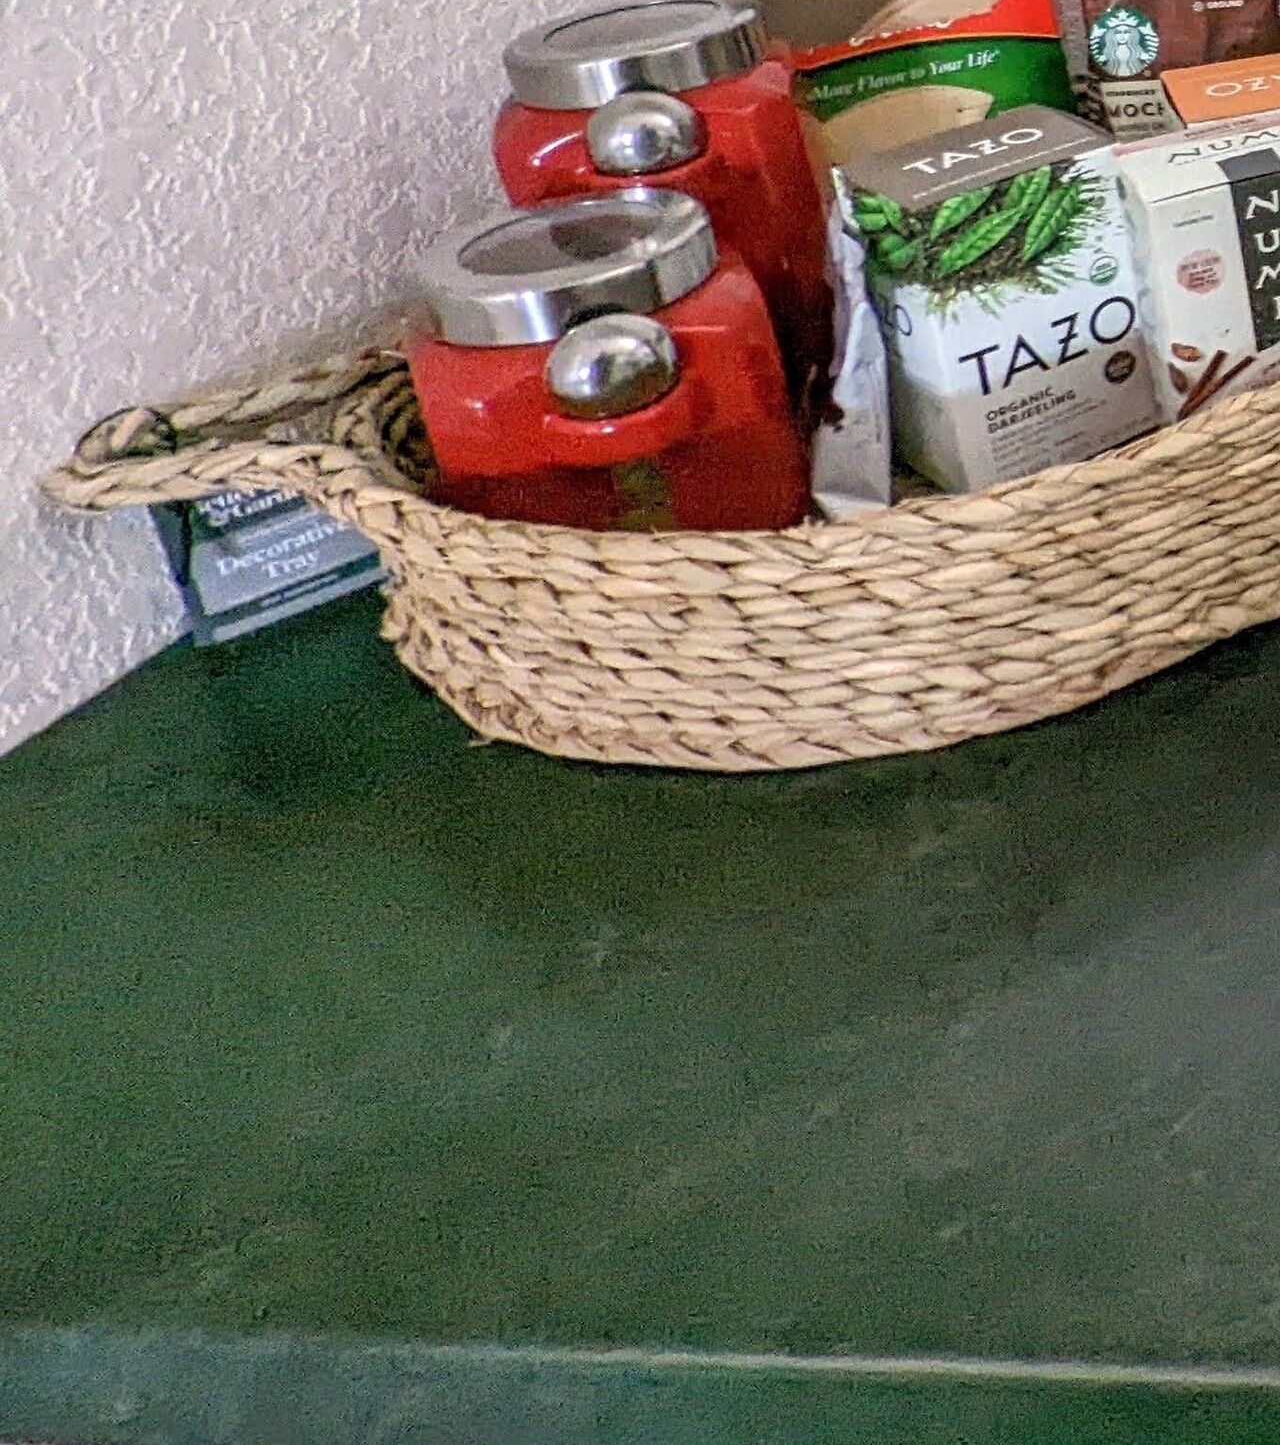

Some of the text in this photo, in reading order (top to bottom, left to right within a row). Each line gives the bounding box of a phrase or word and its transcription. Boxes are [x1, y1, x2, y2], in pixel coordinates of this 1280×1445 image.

[1205, 0, 1244, 10] GROUND
[812, 82, 852, 101] More
[857, 71, 908, 93] Flavor
[929, 57, 963, 75] Your
[901, 127, 1044, 175] TAZO
[957, 295, 1137, 396] TAZO
[985, 386, 1054, 422] ORGANIC
[987, 390, 1077, 434] DARJEELING
[261, 550, 322, 579] Tray
